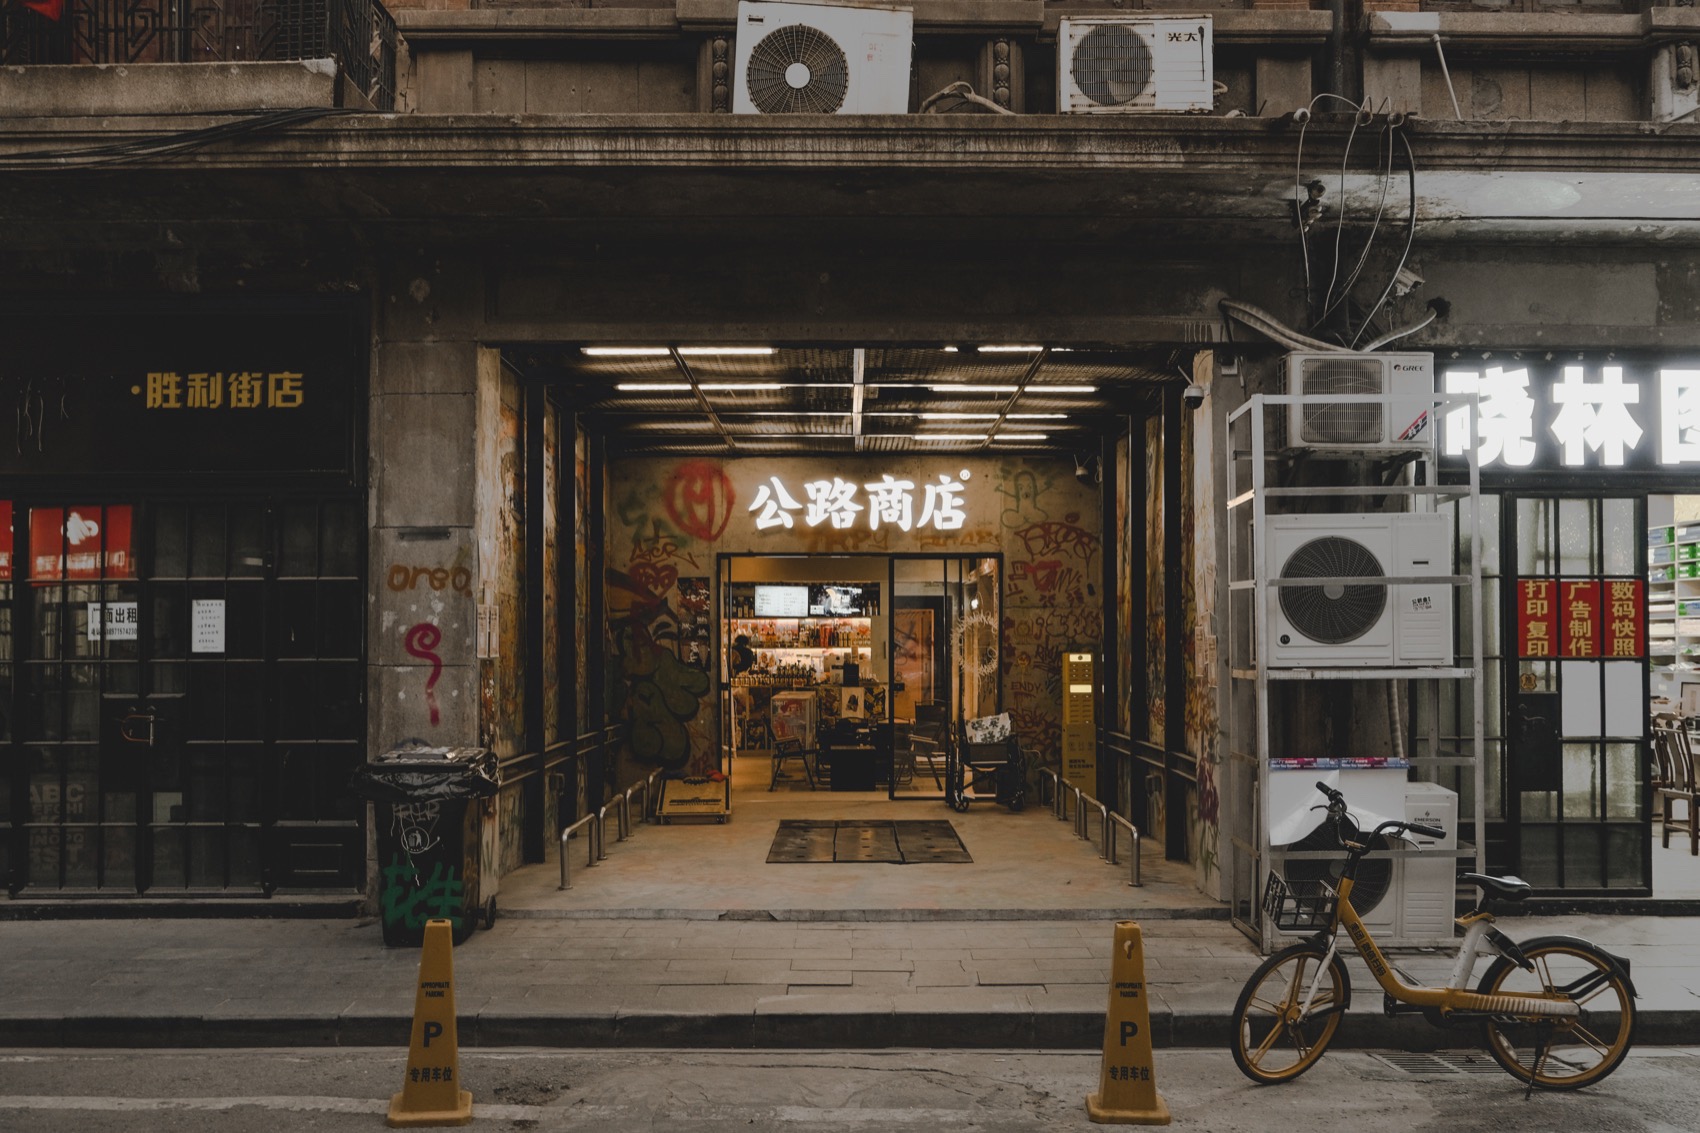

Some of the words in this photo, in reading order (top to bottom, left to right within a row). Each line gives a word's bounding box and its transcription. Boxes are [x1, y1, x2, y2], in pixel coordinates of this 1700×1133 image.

[1525, 580, 1549, 657] 打印复印
[1568, 581, 1593, 657] 广告制作
[1611, 581, 1636, 657] 数码快照
[423, 1021, 443, 1047] P
[1120, 1021, 1138, 1046] P
[410, 1066, 452, 1082] 专用车位
[1109, 1065, 1150, 1081] 专用车位
